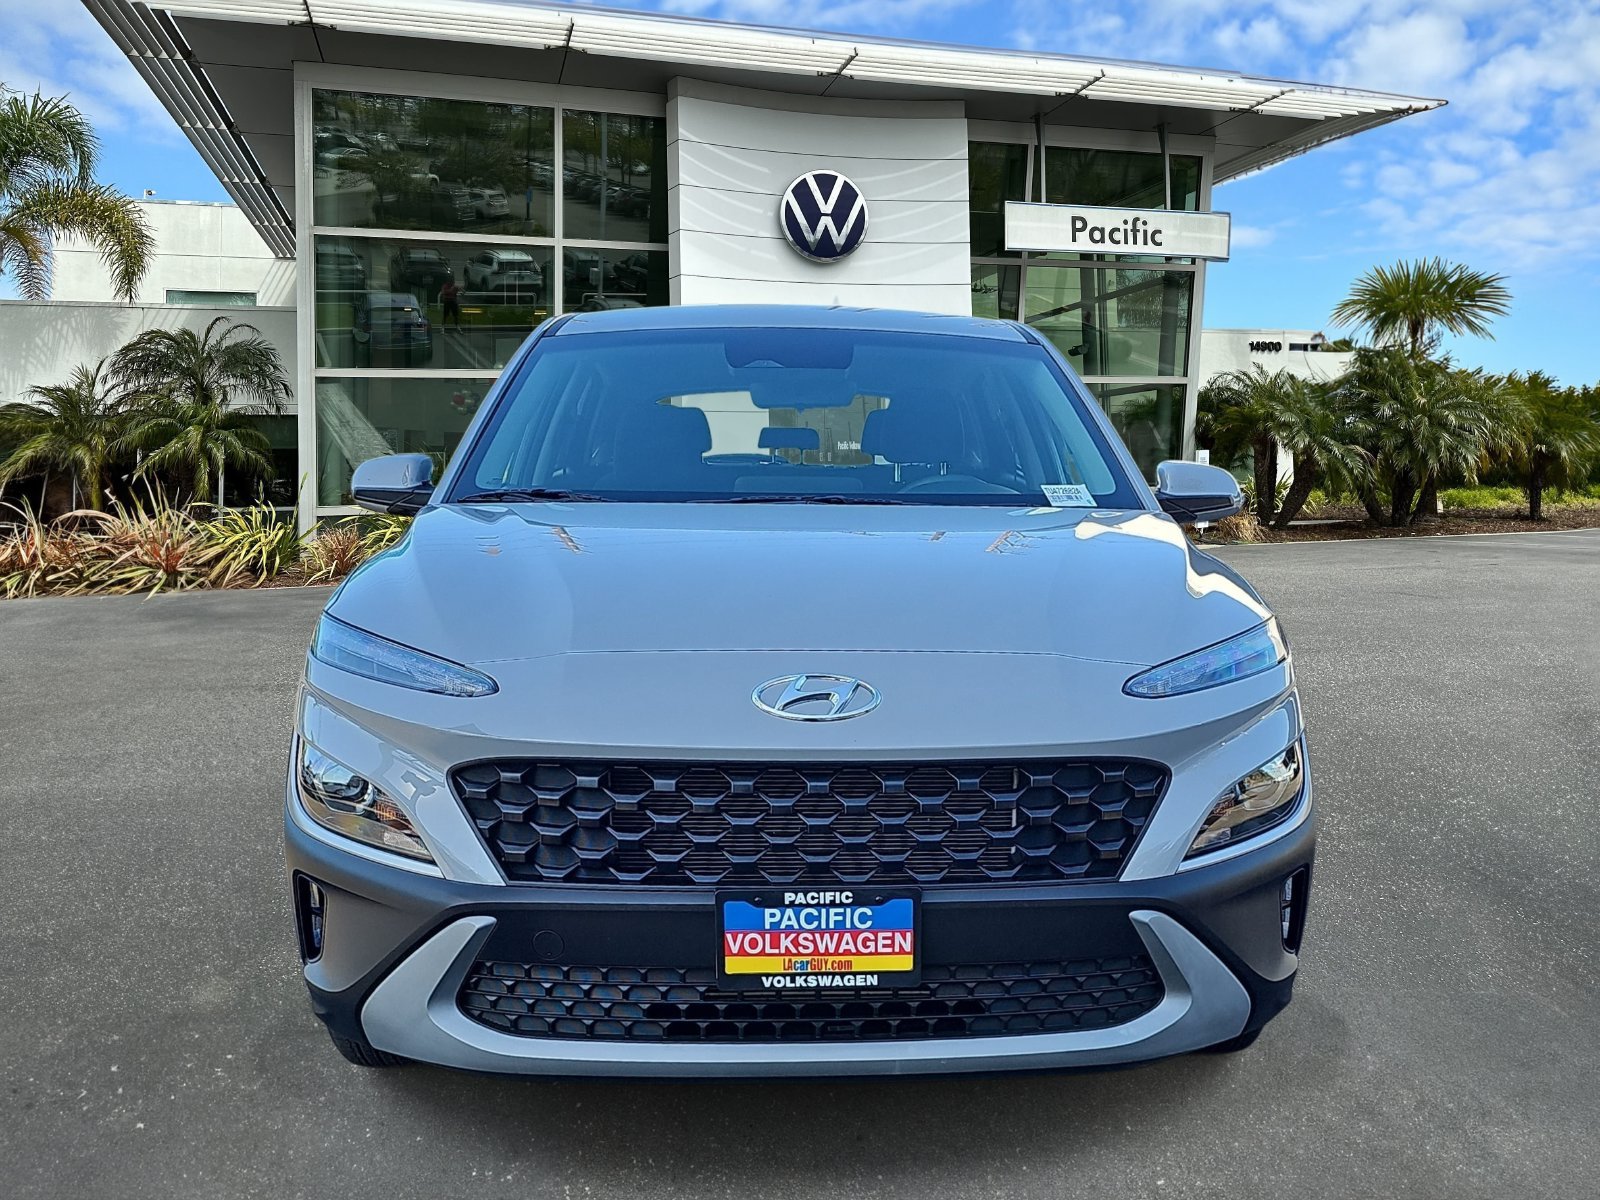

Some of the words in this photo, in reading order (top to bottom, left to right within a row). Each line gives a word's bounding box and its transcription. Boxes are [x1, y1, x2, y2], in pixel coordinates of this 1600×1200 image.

[1071, 215, 1163, 247] Pacific
[1248, 340, 1282, 353] 14900
[784, 892, 853, 904] PACIFIC
[764, 907, 873, 930] PACIFIC
[726, 932, 911, 954] VOLKSWAGEN
[783, 957, 852, 971] LAcarGUY.com
[761, 974, 878, 988] VOLKSWAGEN
